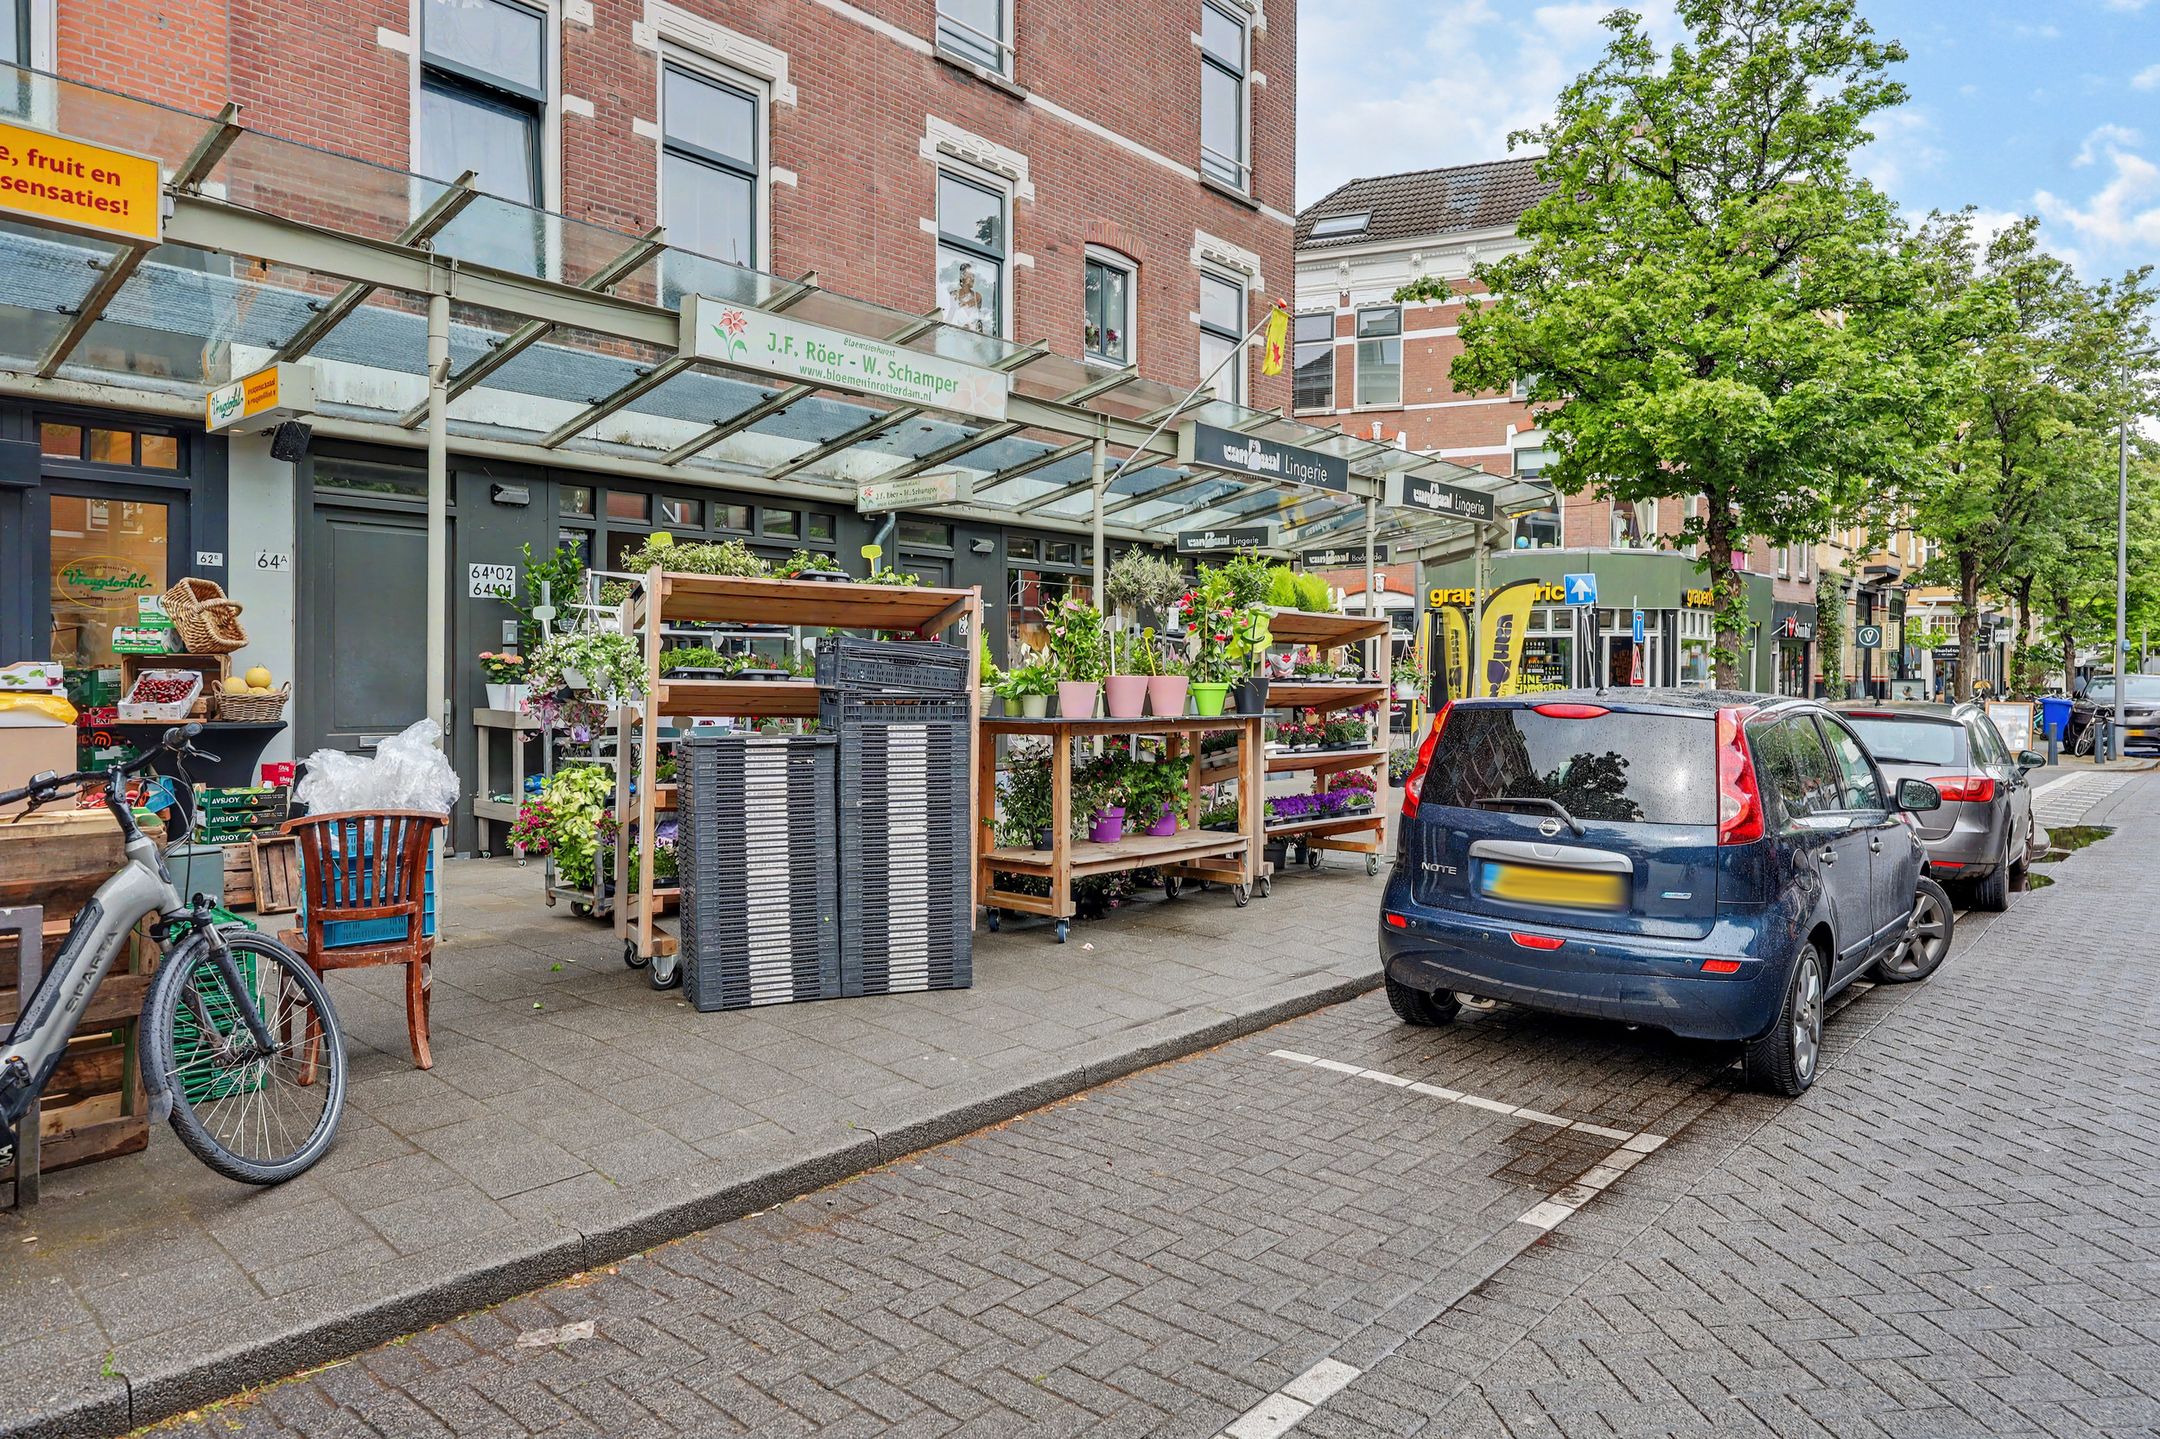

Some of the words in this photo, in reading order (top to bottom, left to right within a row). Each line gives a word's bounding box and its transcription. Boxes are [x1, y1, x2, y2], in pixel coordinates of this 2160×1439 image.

[27, 148, 85, 178] fruit
[91, 168, 121, 187] en
[0, 175, 129, 216] sensaties!
[767, 332, 799, 358] J.F.
[806, 341, 845, 367] Röer
[863, 354, 882, 376] W.
[887, 361, 959, 394] Schamper
[799, 364, 932, 402] www.bloemeninrotterdam.nl
[1285, 454, 1328, 484] Lingerie
[1455, 493, 1486, 517] Lingerie
[1232, 536, 1259, 547] Lingerie
[257, 553, 288, 569] 64A
[1421, 862, 1457, 875] NOTE
[65, 931, 118, 1014] SPARTA
